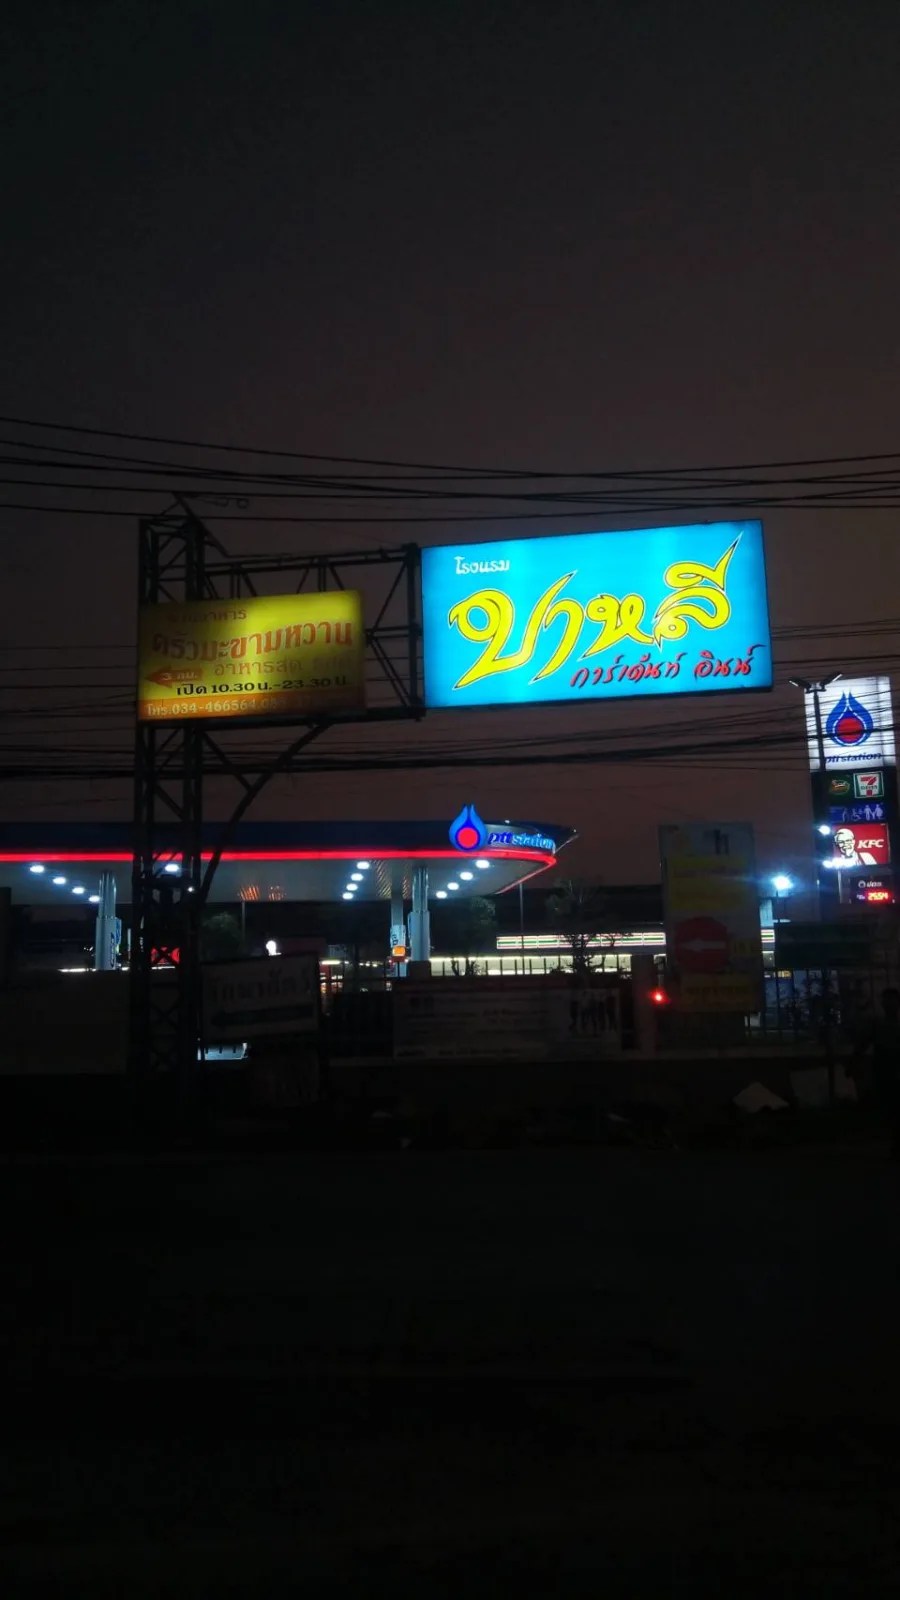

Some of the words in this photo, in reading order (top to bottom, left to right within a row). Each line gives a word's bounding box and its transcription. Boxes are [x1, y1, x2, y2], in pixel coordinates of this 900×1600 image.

[454, 555, 510, 574] โรงแรม
[151, 621, 353, 660] ครัวมะขามหวาน
[176, 683, 208, 695] เปิด
[857, 838, 885, 849] KFC
